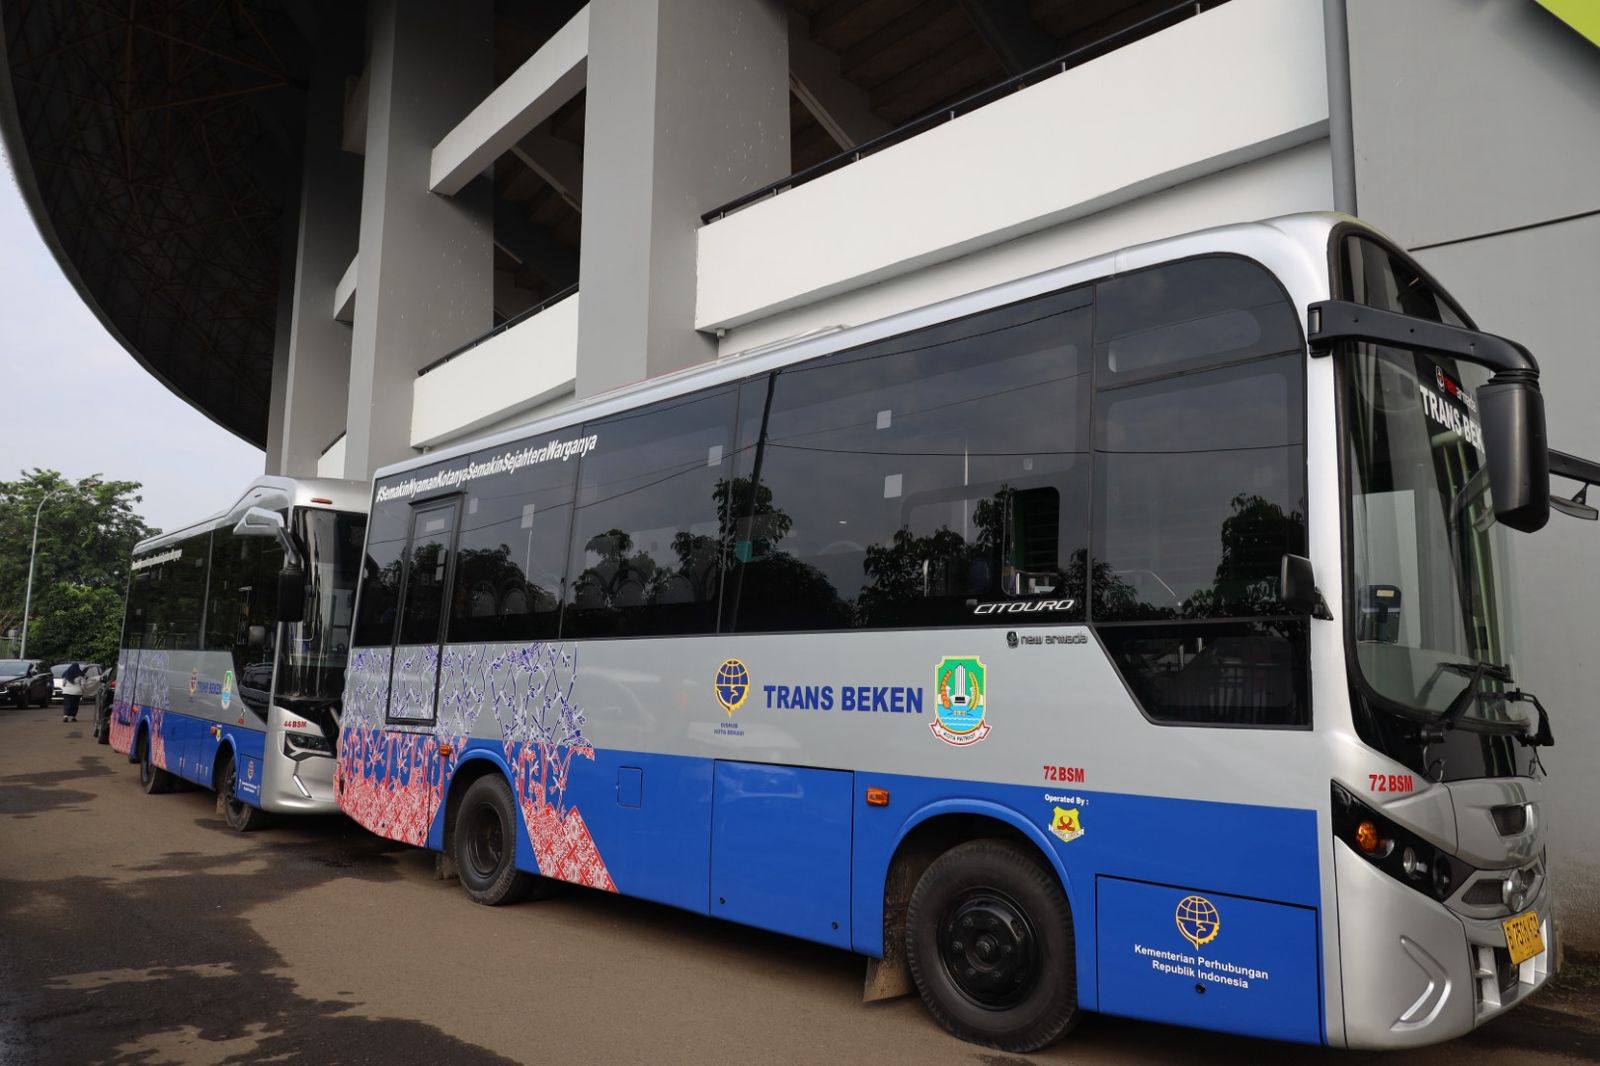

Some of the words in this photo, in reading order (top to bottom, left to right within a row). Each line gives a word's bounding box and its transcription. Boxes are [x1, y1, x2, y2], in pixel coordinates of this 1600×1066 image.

[1419, 384, 1462, 437] TRANS
[973, 599, 1075, 614] CITOURO
[1020, 634, 1043, 645] new
[1045, 631, 1088, 645] armada
[763, 685, 834, 711] TRANS
[841, 686, 923, 714] BEKEN
[1044, 793, 1075, 804] Operated
[1134, 943, 1195, 965] Kementerian
[1197, 956, 1269, 980] Perhubungan
[1152, 960, 1195, 978] Republik
[1197, 969, 1249, 989] Indonesia
